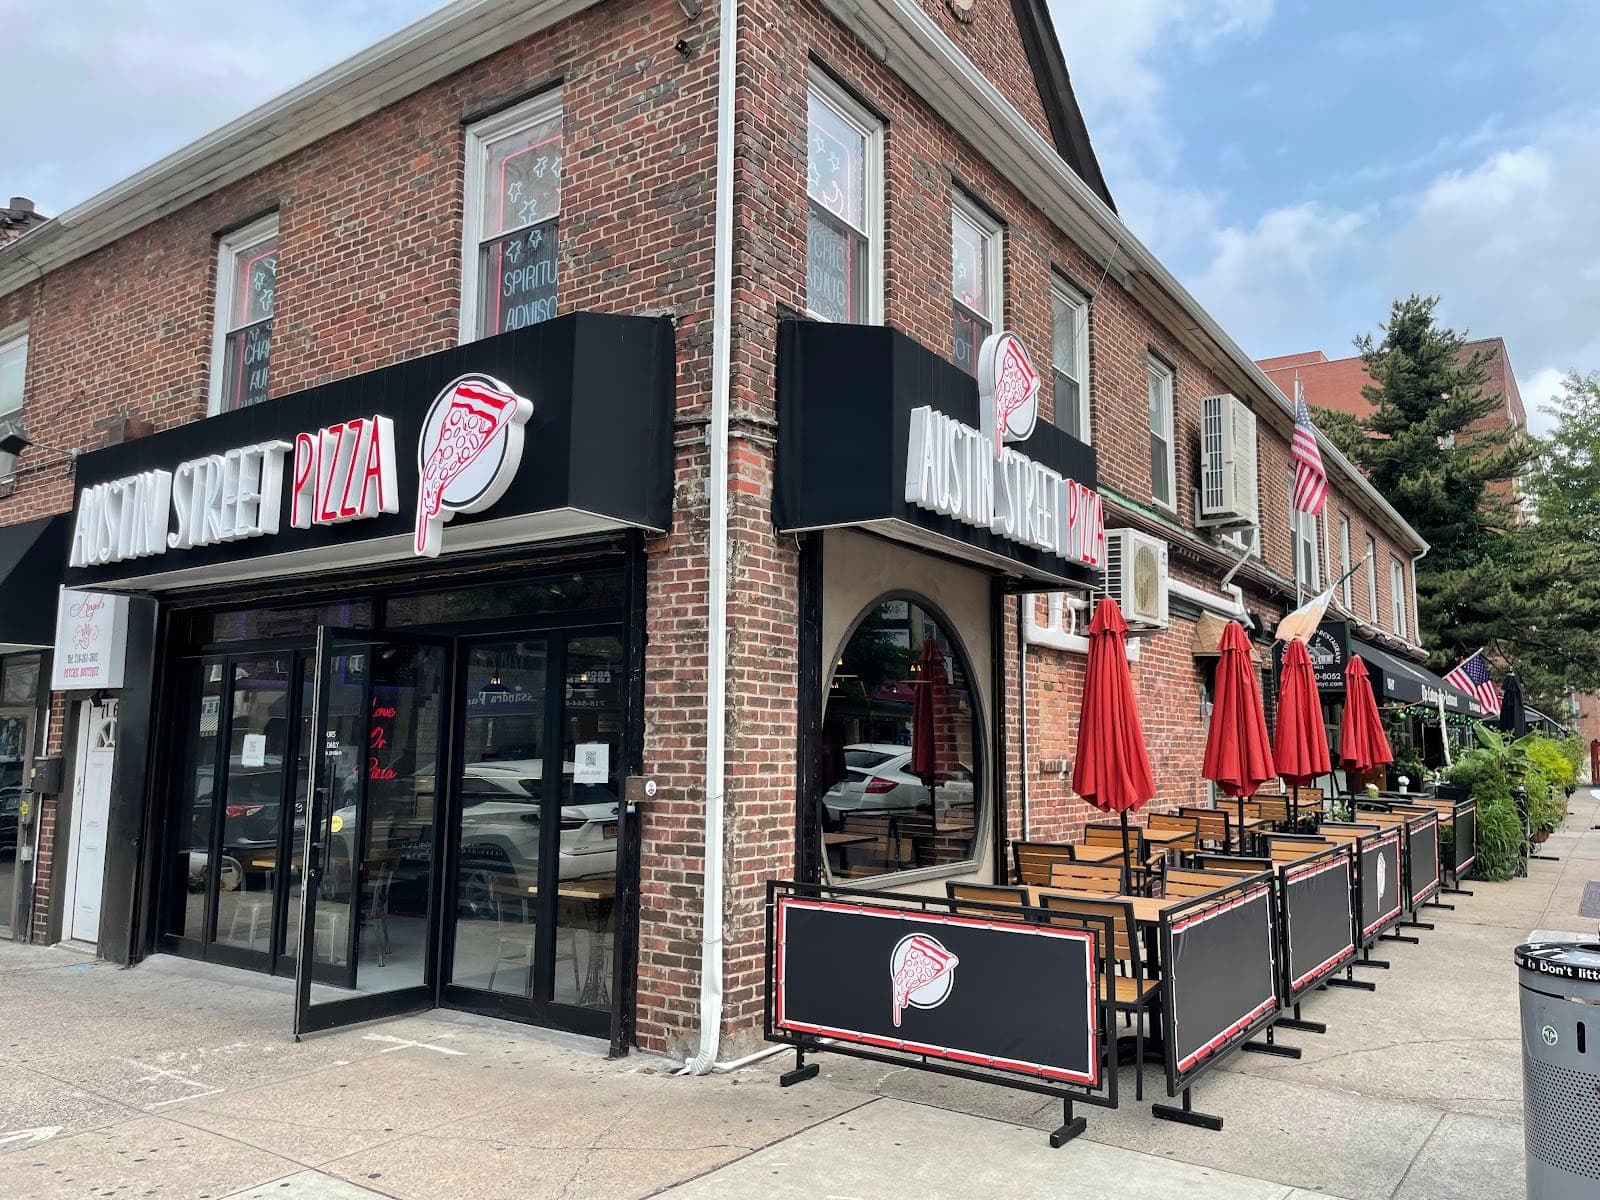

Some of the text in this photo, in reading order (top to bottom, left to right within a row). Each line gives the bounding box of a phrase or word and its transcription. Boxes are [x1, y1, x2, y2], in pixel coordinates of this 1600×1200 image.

[504, 258, 558, 296] SPIRITU
[70, 414, 399, 568] AUSTIN STREET PIZZA
[905, 405, 1107, 571] AUSTIN STREET PIZZA
[1539, 960, 1573, 977] Don't
[1578, 967, 1600, 981] litt
